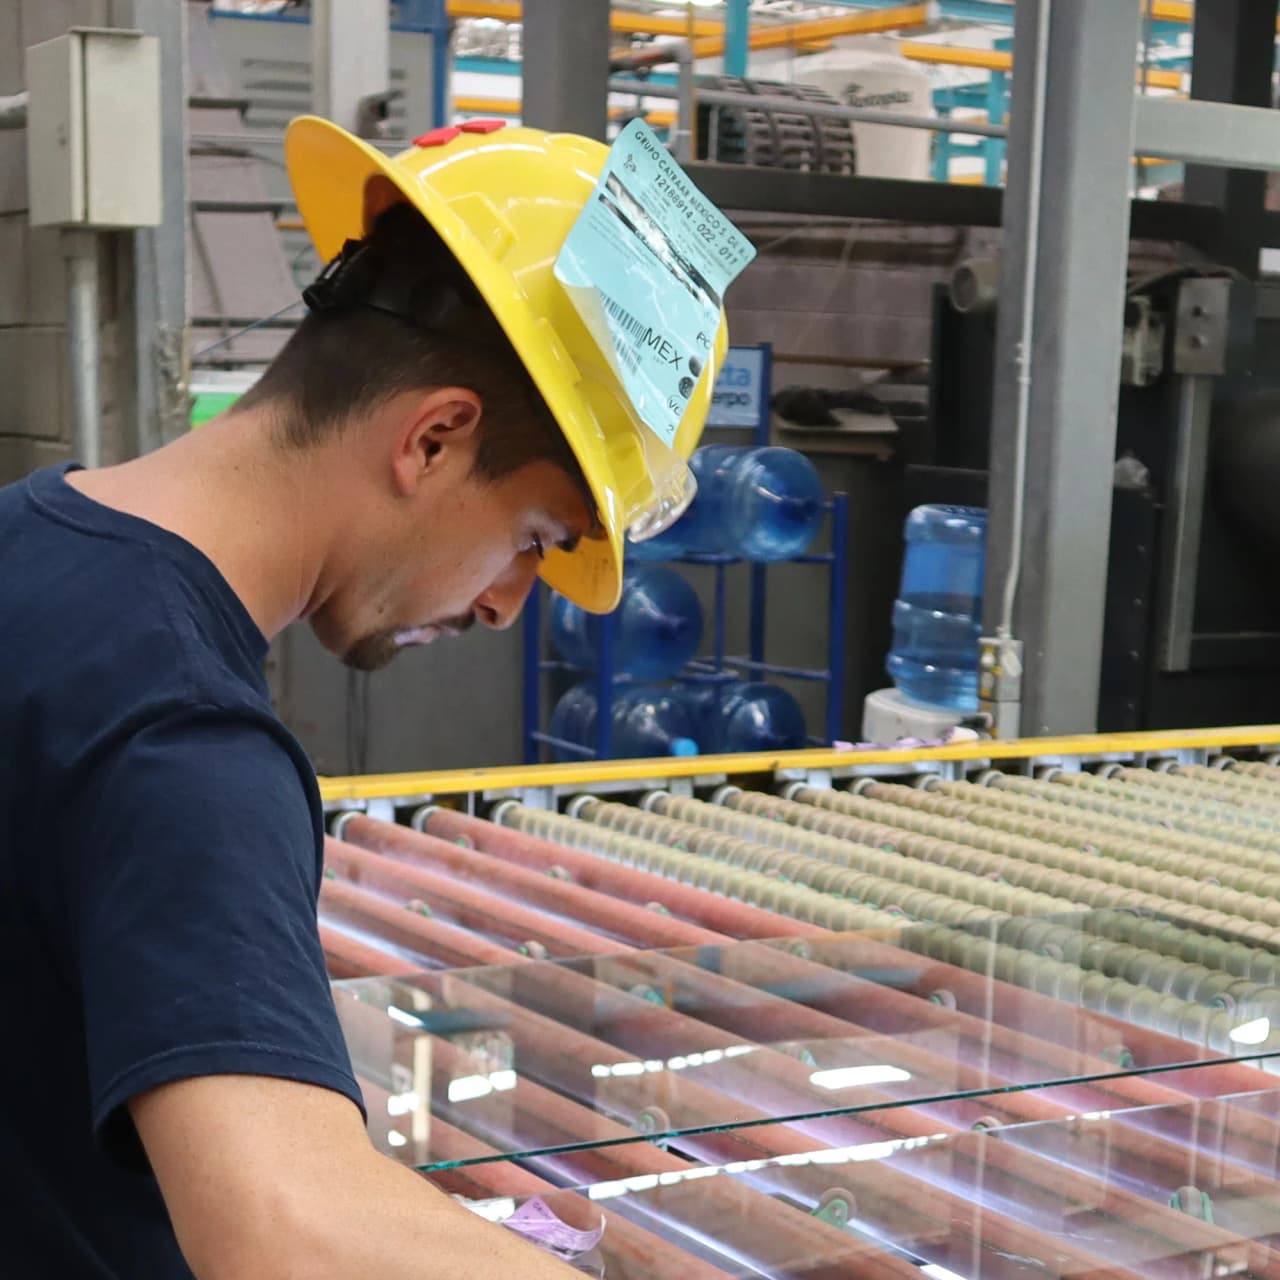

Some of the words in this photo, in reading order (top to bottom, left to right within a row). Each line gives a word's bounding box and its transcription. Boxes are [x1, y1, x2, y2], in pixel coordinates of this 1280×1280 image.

[634, 130, 660, 161] GRUPO
[690, 195, 720, 230] MEXICO
[696, 223, 717, 244] 022
[642, 327, 684, 372] MEX
